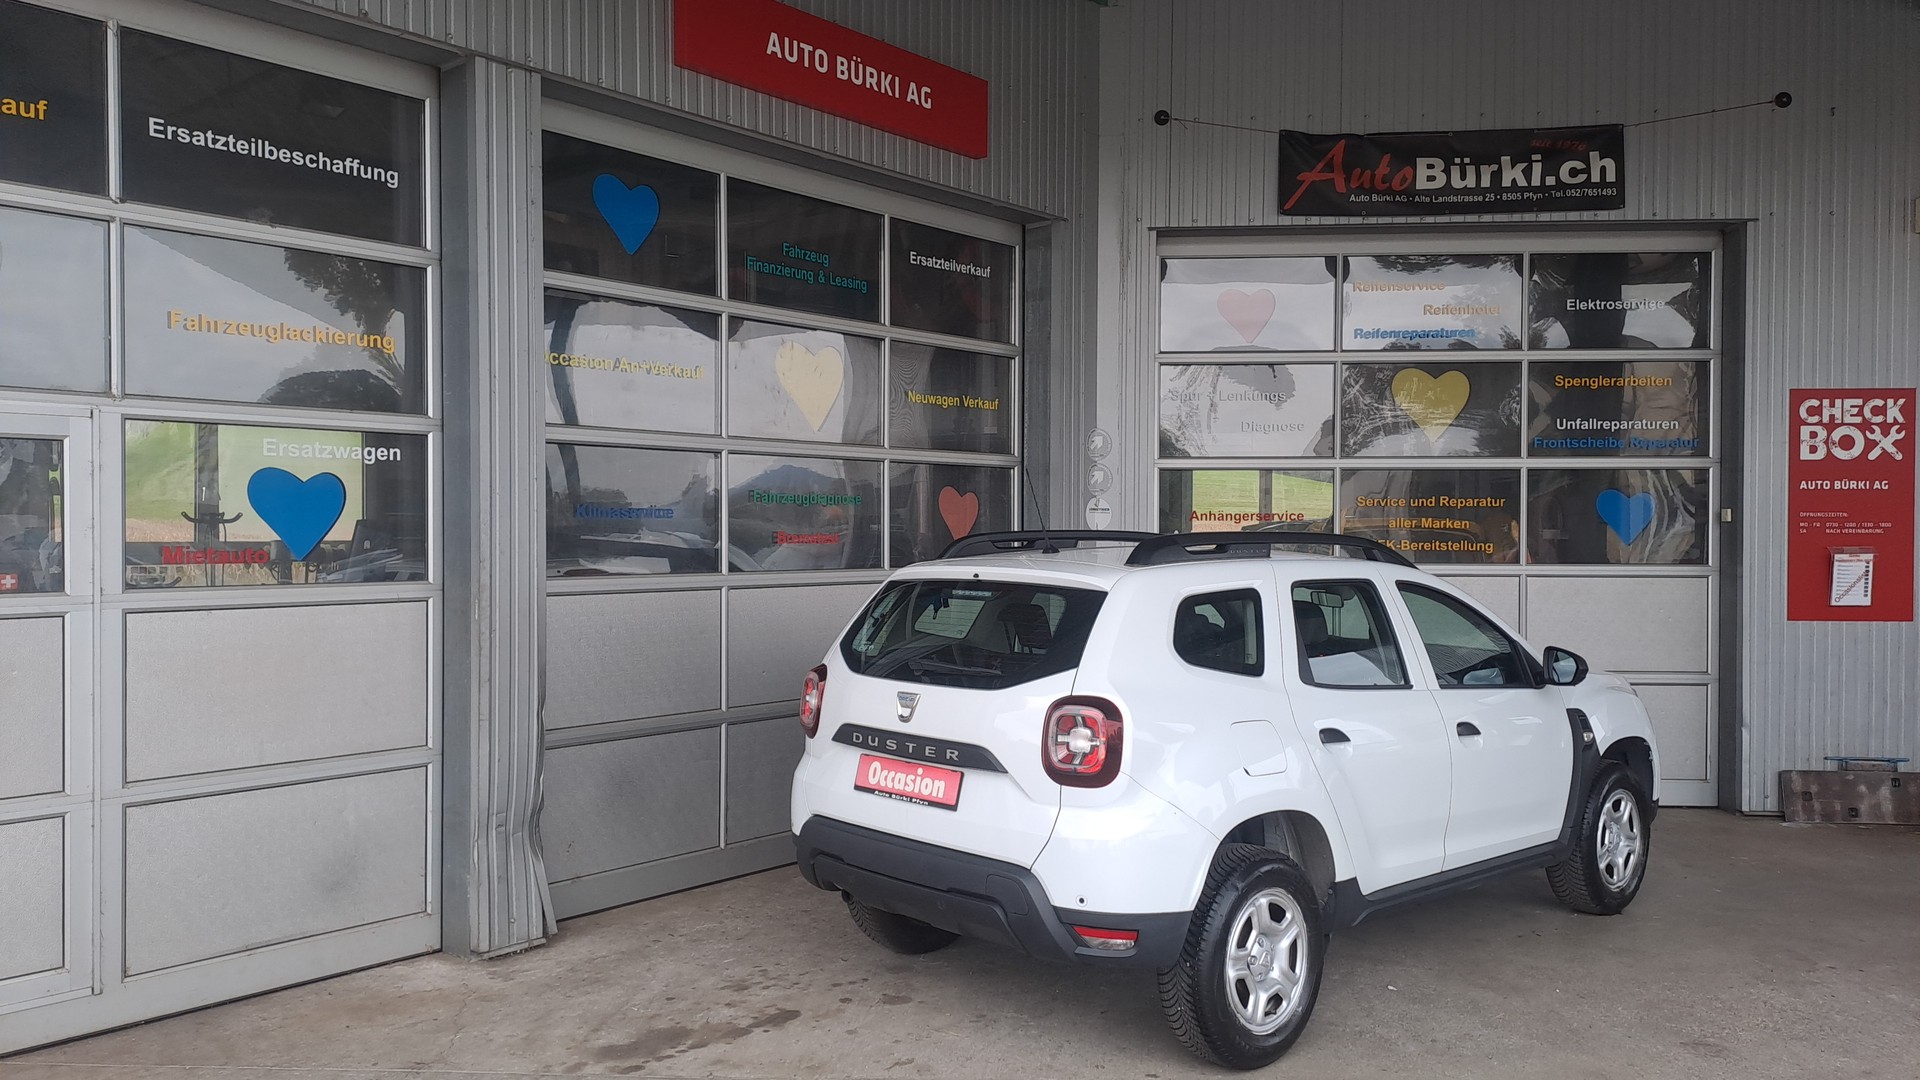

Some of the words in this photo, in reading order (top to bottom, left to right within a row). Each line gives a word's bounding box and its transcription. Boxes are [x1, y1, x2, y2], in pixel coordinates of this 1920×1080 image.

[766, 32, 829, 73] AUTO
[836, 55, 900, 98] BÜRKI
[906, 82, 932, 109] AG
[148, 116, 400, 189] Ersatzteilbeschaffung
[1349, 193, 1370, 202] Auto
[1372, 193, 1394, 202] Bürki
[1395, 194, 1408, 202] AG
[1414, 195, 1431, 203] Alte
[1432, 194, 1483, 203] Landstrasse
[1485, 193, 1495, 201] 25
[1502, 192, 1522, 201] 8505
[1523, 192, 1543, 201] Pfyn
[782, 242, 830, 267] Fahrzeug
[909, 251, 991, 279] Ersatzteilverkauf
[746, 255, 814, 284] Finanzierung
[818, 271, 826, 284] &
[829, 272, 868, 294] Leasing
[1352, 281, 1446, 292] Reifenservice
[1423, 304, 1503, 316] Reifenhotel
[1566, 298, 1665, 311] Elektroservice
[167, 309, 397, 354] Fahrzeuglackierung
[1353, 327, 1478, 340] Reifenreparaturen
[1554, 374, 1672, 389] Spenglerarbeiten
[907, 390, 960, 409] Neuwagen
[962, 395, 999, 410] Verkauf
[1219, 389, 1287, 404] Lenkungs
[1799, 398, 1906, 424] CHECK
[1240, 421, 1305, 434] Diagnose
[1556, 417, 1679, 432] Unfallreparaturen
[1533, 436, 1625, 449] Frontscheibe
[1629, 436, 1700, 450] Reparatur
[1799, 425, 1906, 460] BOX
[262, 437, 402, 465] Ersatzwagen
[1799, 480, 1831, 490] AUTO
[1834, 478, 1870, 490] BÜRKI
[1873, 479, 1889, 490] AG
[753, 488, 862, 507] Fahrzeugdiagnose
[1357, 495, 1407, 508] Service
[1410, 495, 1436, 508] und
[1440, 496, 1506, 510] Reparatur
[1189, 509, 1305, 524] Anhängerservice
[1388, 517, 1418, 530] aller
[1420, 518, 1470, 530] Marken
[161, 545, 270, 565] Mietauto
[852, 732, 959, 761] DUSTER
[868, 760, 946, 799] Occasion
[874, 790, 890, 798] Auto
[891, 794, 910, 802] Bürki
